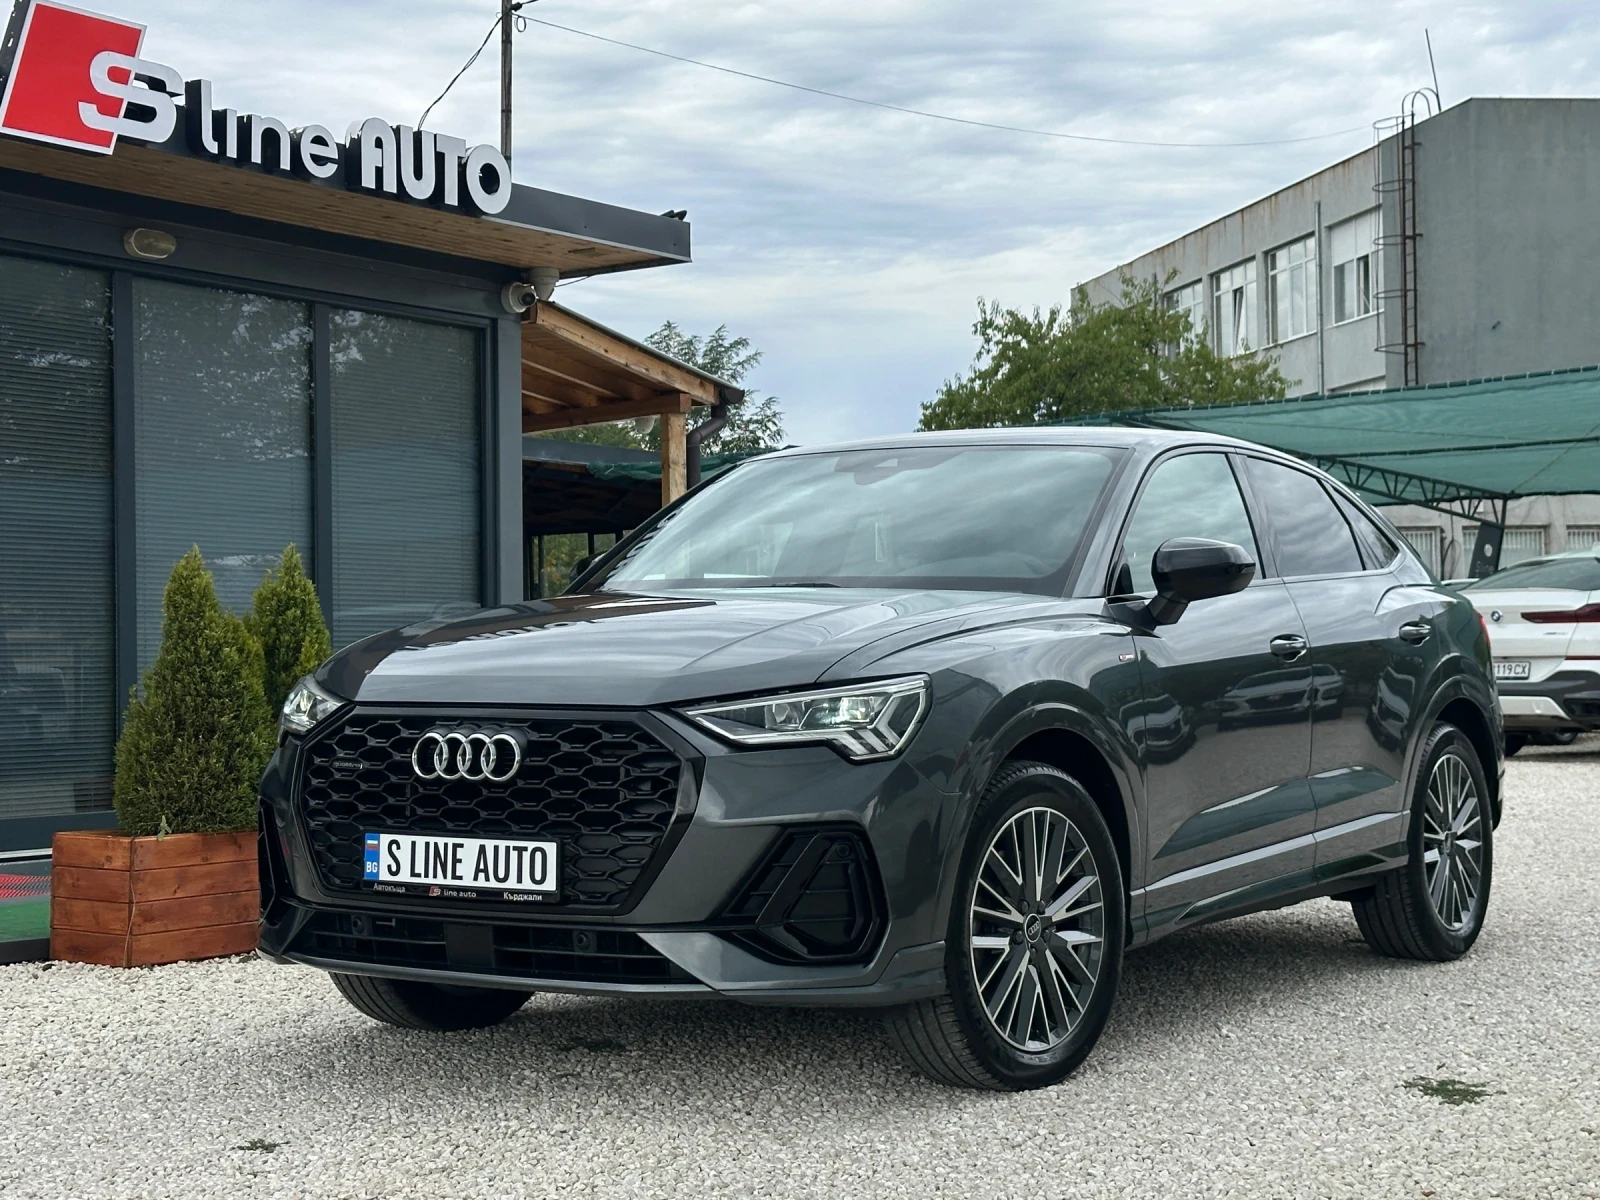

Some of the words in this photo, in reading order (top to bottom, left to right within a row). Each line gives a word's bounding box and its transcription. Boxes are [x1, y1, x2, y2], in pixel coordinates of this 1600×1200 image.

[78, 50, 184, 144] S
[199, 78, 339, 179] line
[358, 117, 512, 215] AUTO
[1493, 664, 1527, 675] 119CX
[366, 861, 378, 873] BG
[387, 839, 401, 877] S
[409, 840, 464, 881] LINE
[473, 843, 548, 886] AUTO
[443, 888, 457, 897] line
[459, 890, 477, 898] auto
[503, 892, 543, 902] Кърджали
